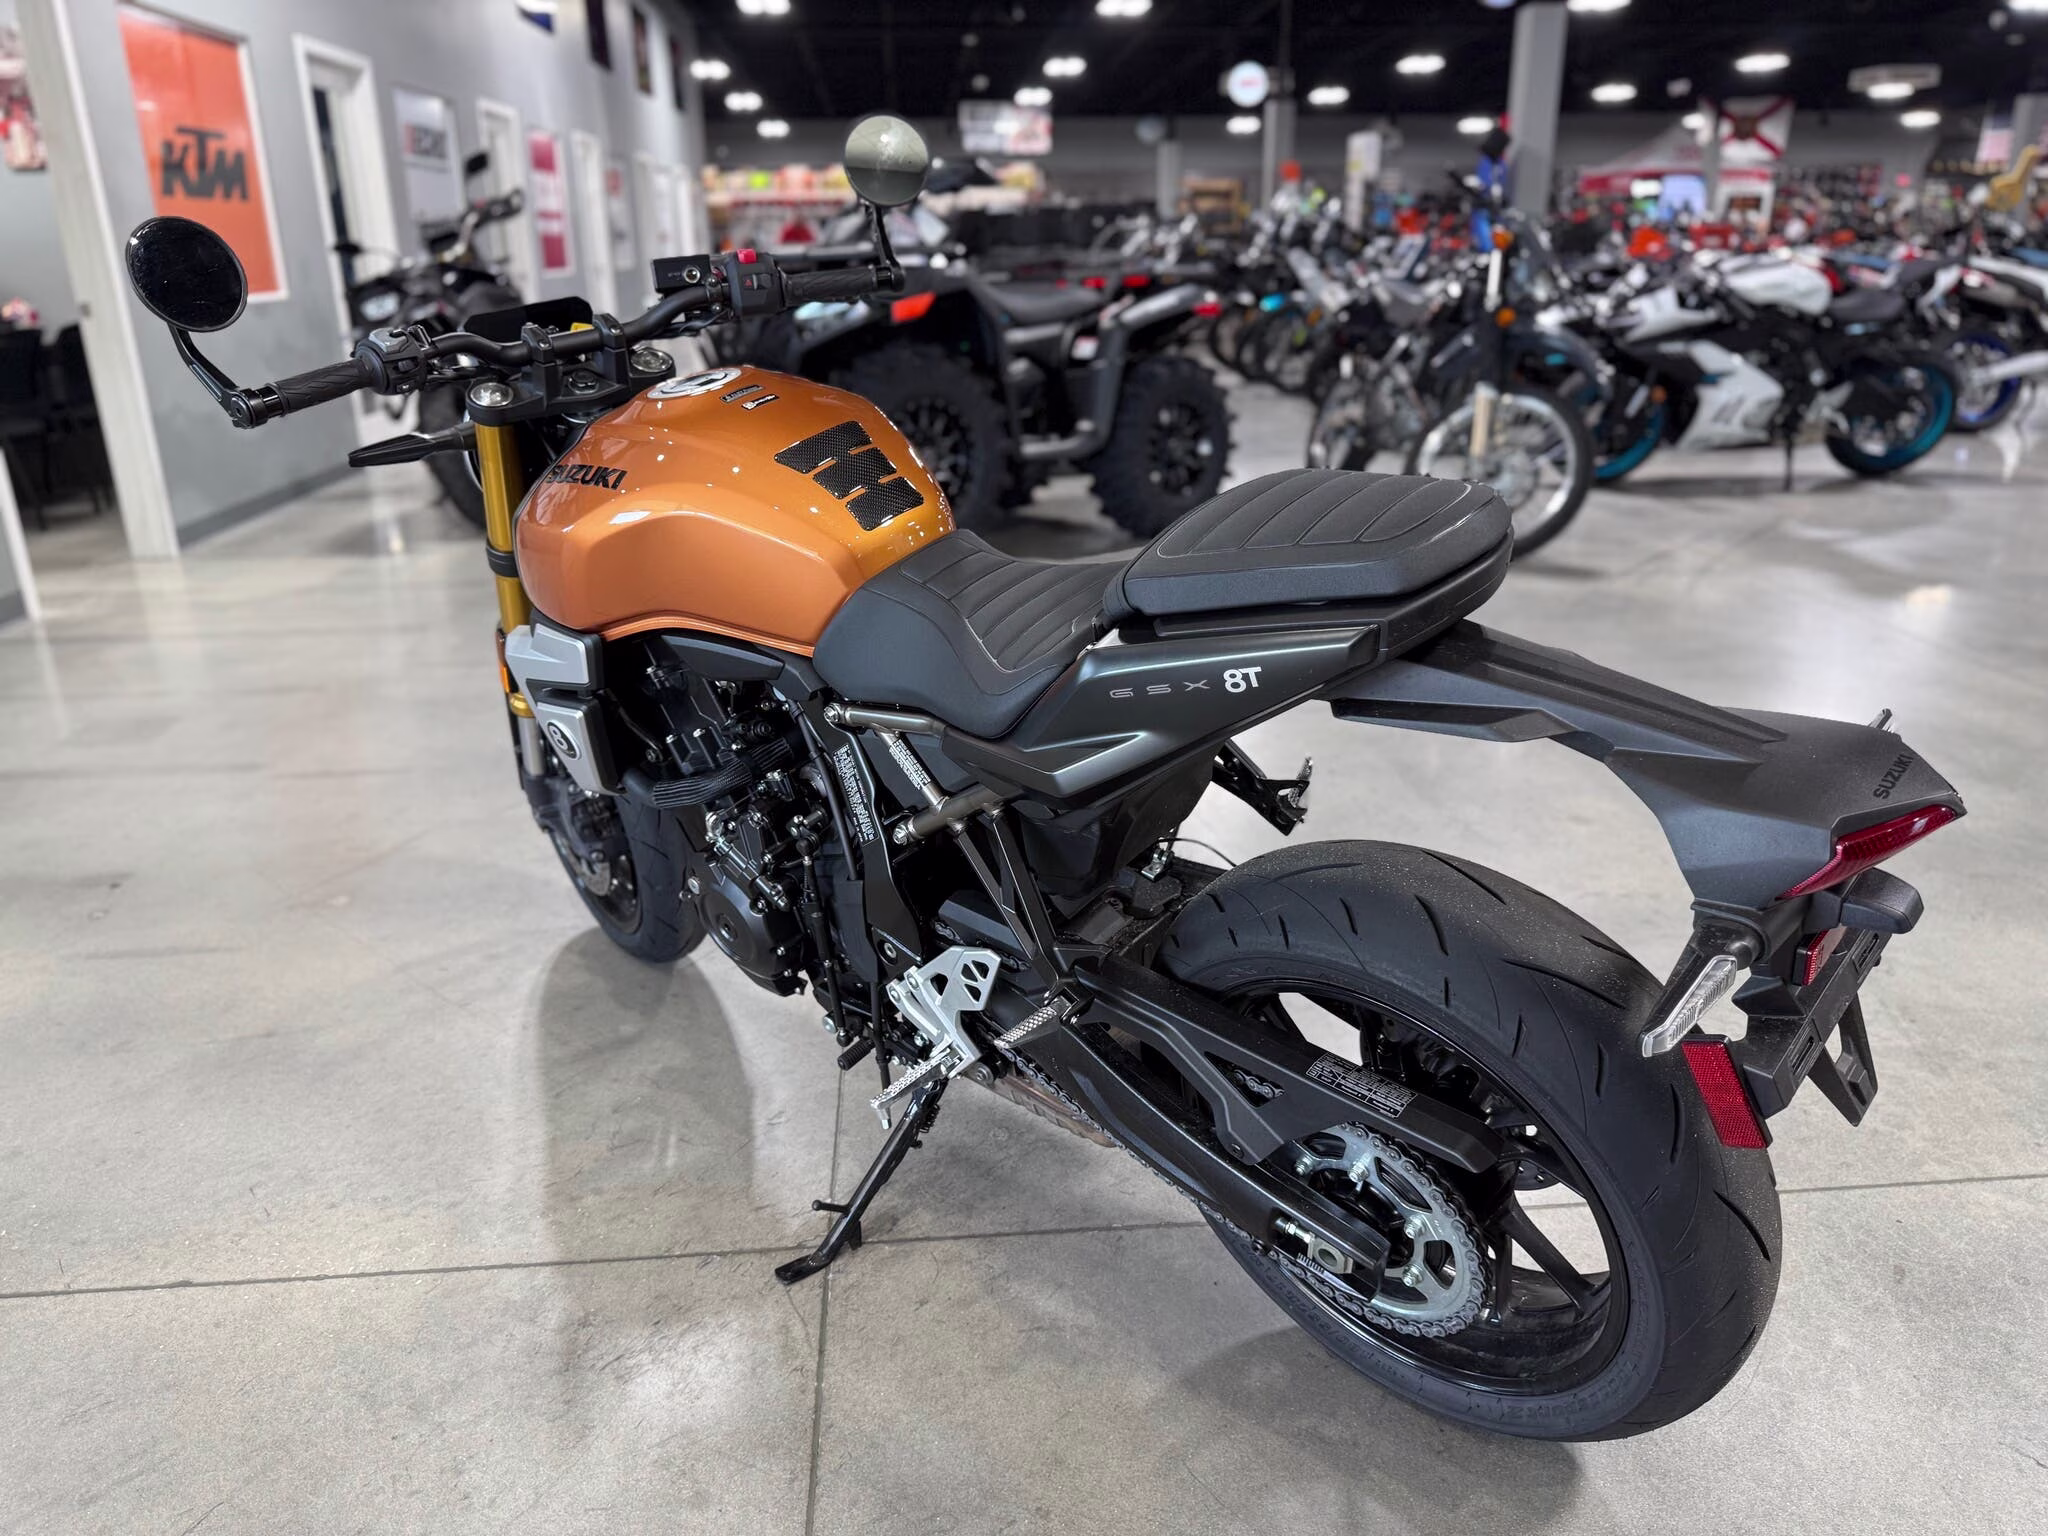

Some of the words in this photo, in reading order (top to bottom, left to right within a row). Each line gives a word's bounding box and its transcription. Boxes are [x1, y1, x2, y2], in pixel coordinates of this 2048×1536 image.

[161, 126, 250, 201] KTM
[545, 463, 628, 490] SUZUKI
[1223, 666, 1262, 694] 8T
[1873, 753, 1915, 800] SUZUKI
